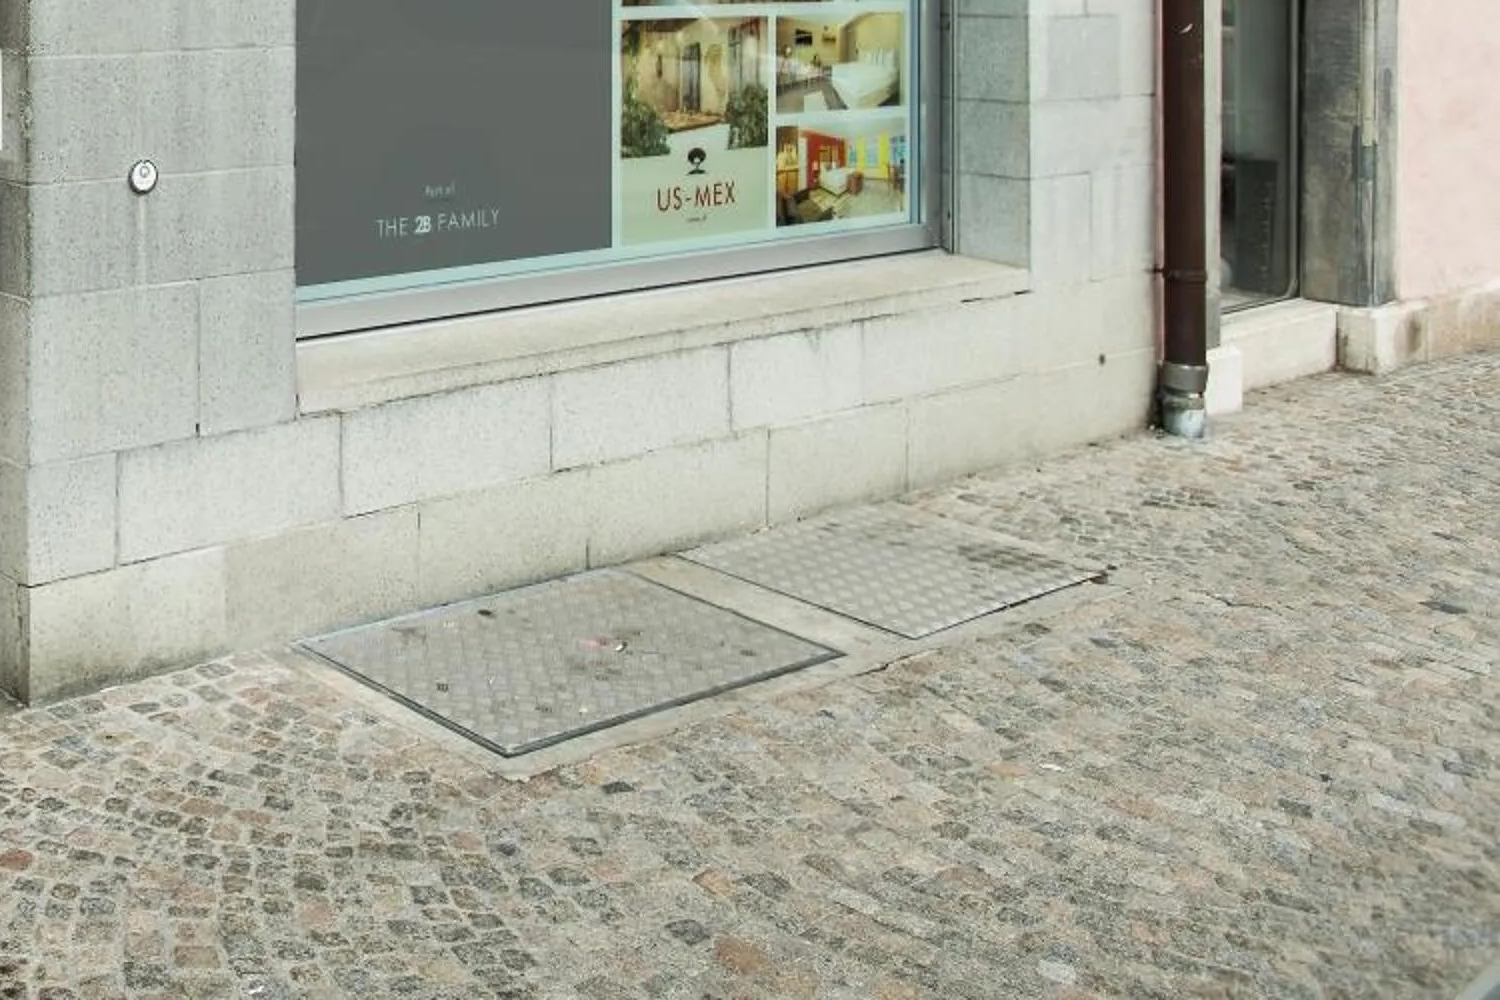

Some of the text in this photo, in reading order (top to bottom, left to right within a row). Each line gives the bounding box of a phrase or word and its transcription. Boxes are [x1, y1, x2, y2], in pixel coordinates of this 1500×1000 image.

[657, 180, 736, 212] US-MEX
[376, 207, 500, 240] THE 2B FAMILY
